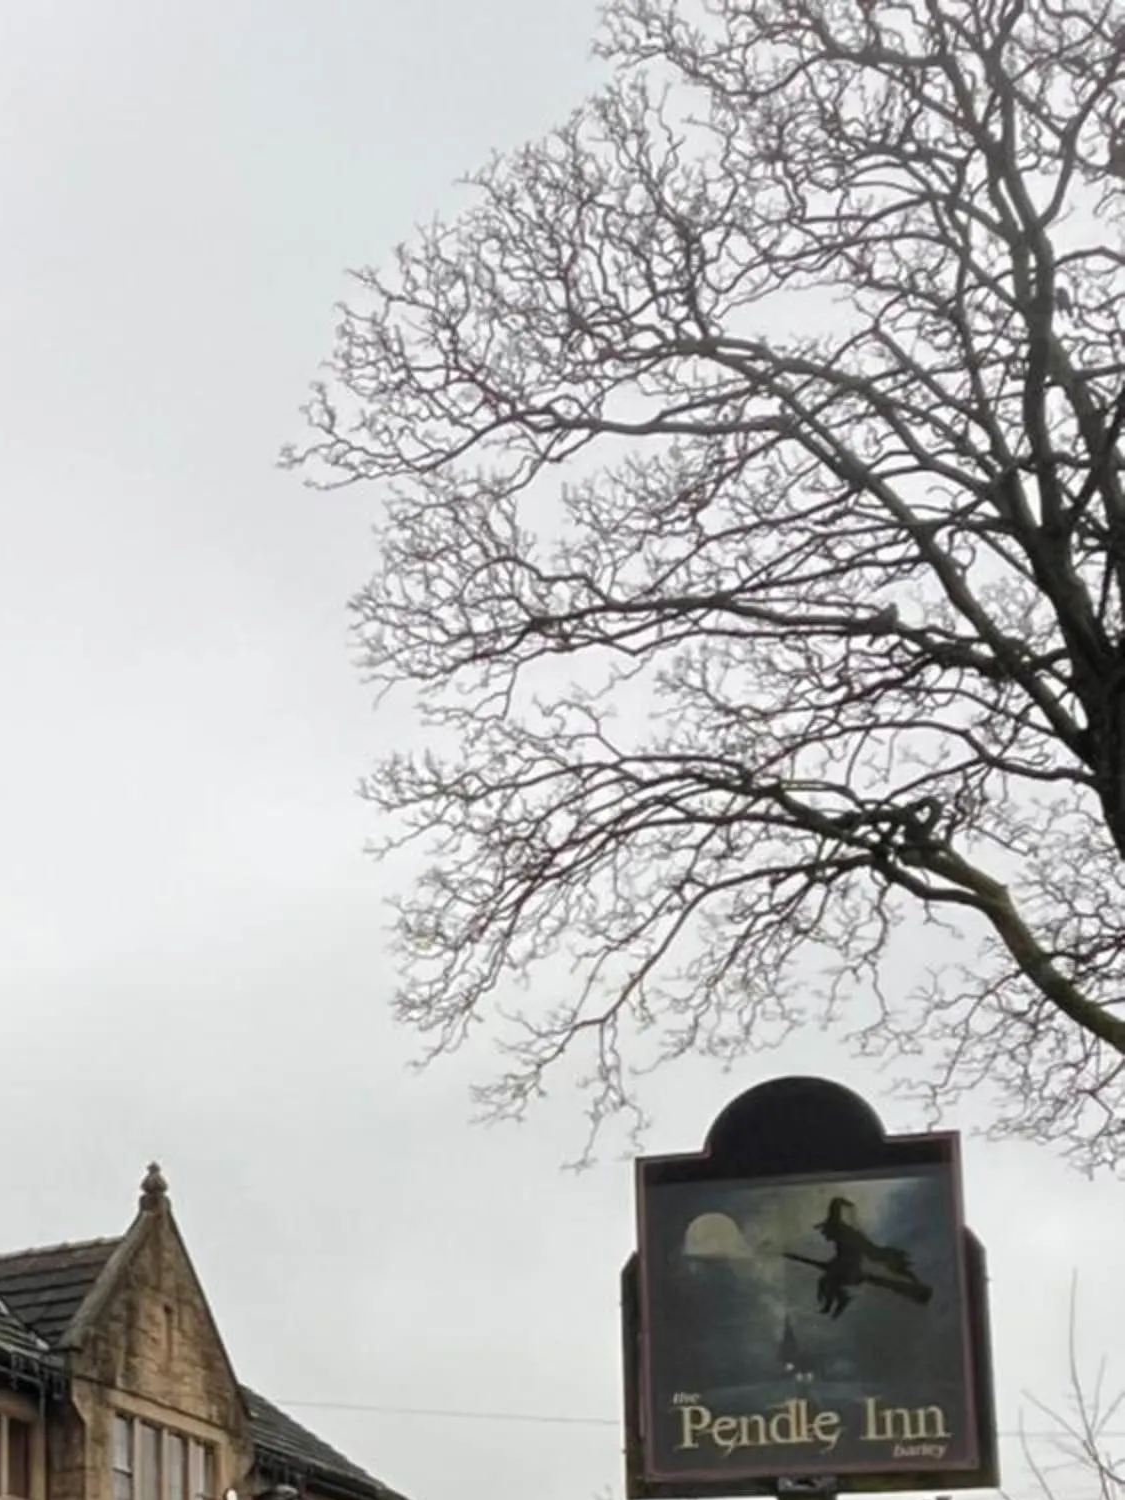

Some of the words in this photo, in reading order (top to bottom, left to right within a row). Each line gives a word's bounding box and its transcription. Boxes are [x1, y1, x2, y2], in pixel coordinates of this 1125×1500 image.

[672, 1391, 701, 1405] the
[675, 1397, 843, 1456] Pendle
[860, 1396, 952, 1441] Inn
